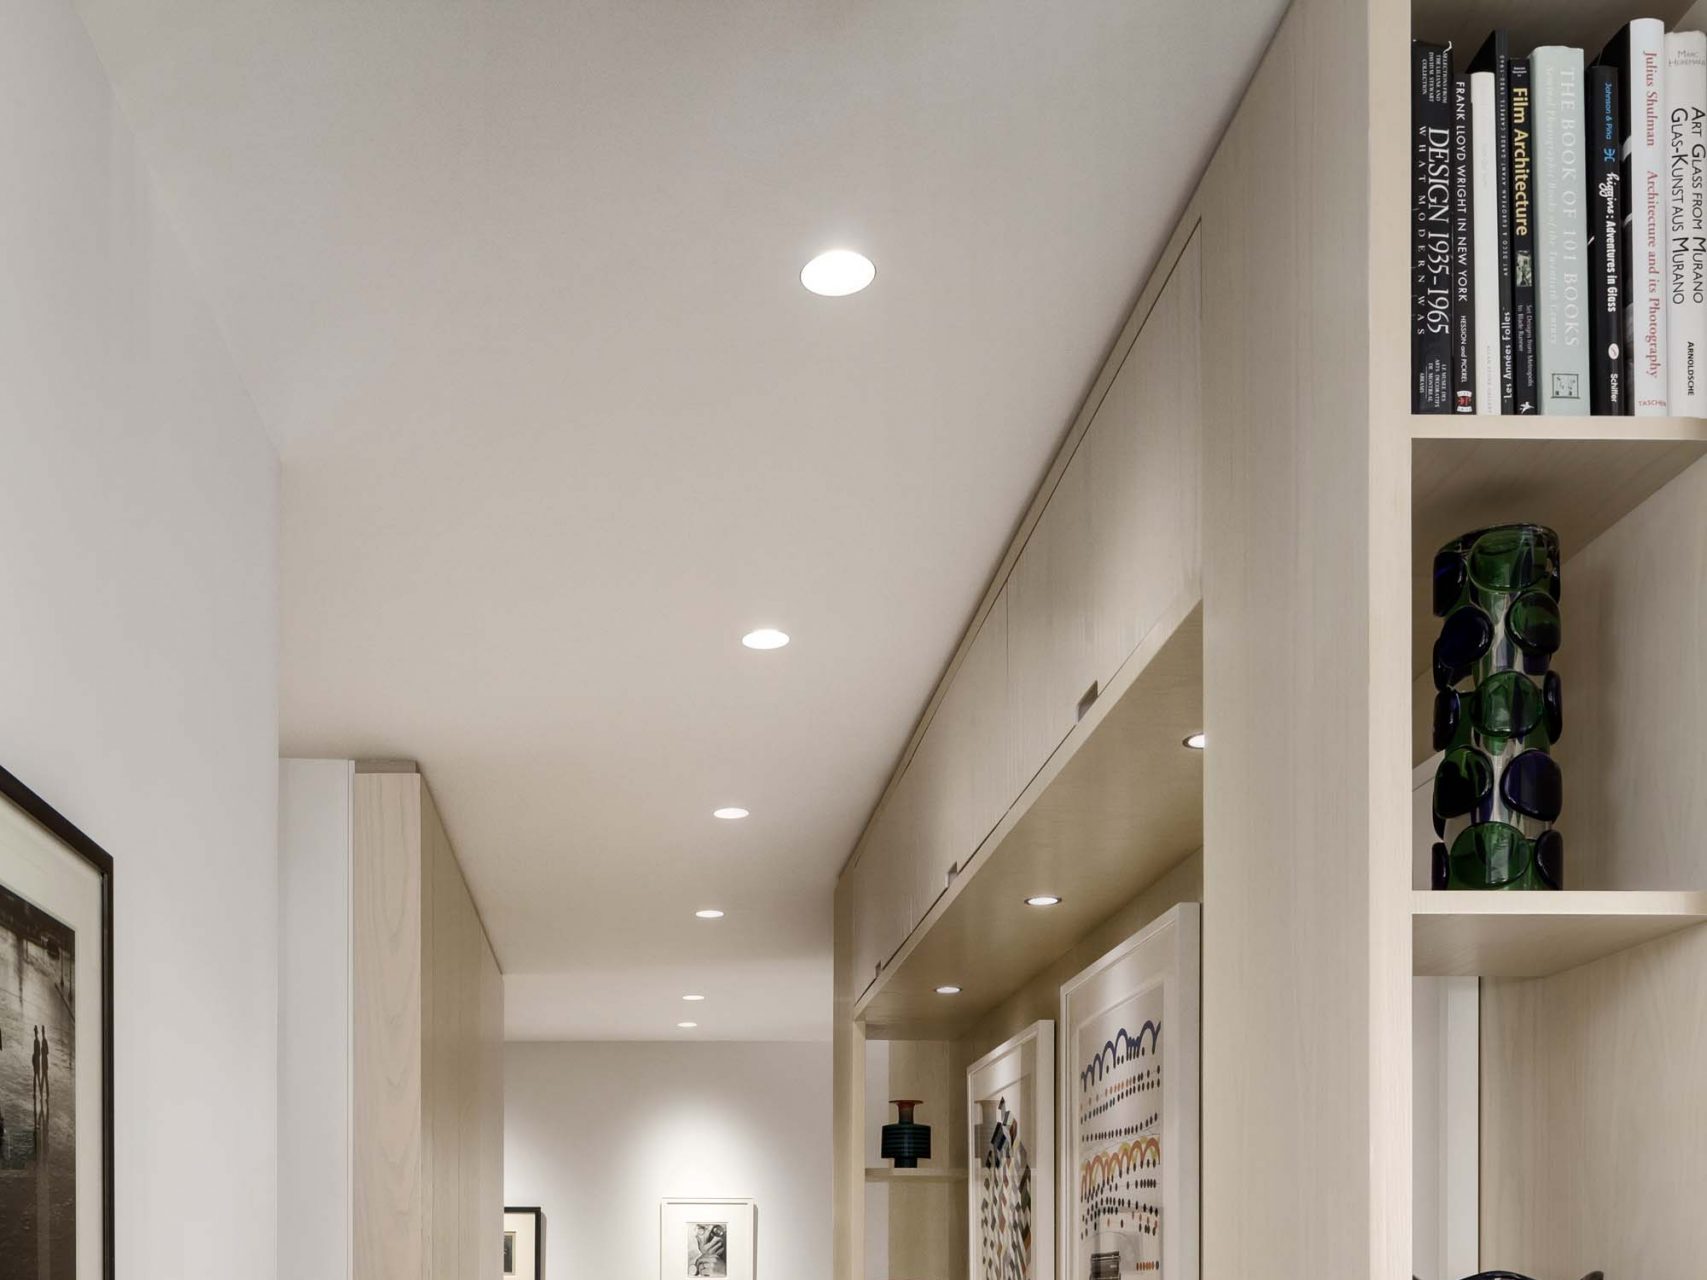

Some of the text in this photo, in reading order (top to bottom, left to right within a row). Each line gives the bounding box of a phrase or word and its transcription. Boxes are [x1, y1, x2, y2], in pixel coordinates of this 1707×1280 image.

[1513, 88, 1529, 123] Film
[1604, 82, 1612, 113] Johnson
[1643, 51, 1658, 146] Julius Shulman
[1456, 82, 1468, 302] FRANK LLOYD WRIGHT IN NEW YORK
[1514, 129, 1530, 236] Architecture
[1560, 67, 1580, 346] THE BOOK OF 101 BOOKS
[1671, 108, 1689, 304] GLAS-KUNST AUS MURANO
[1691, 107, 1706, 304] ART GLASS FROM MURANO
[1417, 125, 1427, 335] WHAT MODERN WAS
[1427, 127, 1450, 334] DESIGN 1935-1965
[1606, 220, 1617, 273] Adventures
[1607, 275, 1617, 285] in
[1607, 286, 1618, 312] Glass
[1645, 171, 1661, 378] Architecture and its Photography
[1503, 344, 1512, 379] Années
[1525, 315, 1533, 339] Designs
[1610, 373, 1618, 402] Schiffer
[1687, 341, 1695, 396] ARNOLDSCHE
